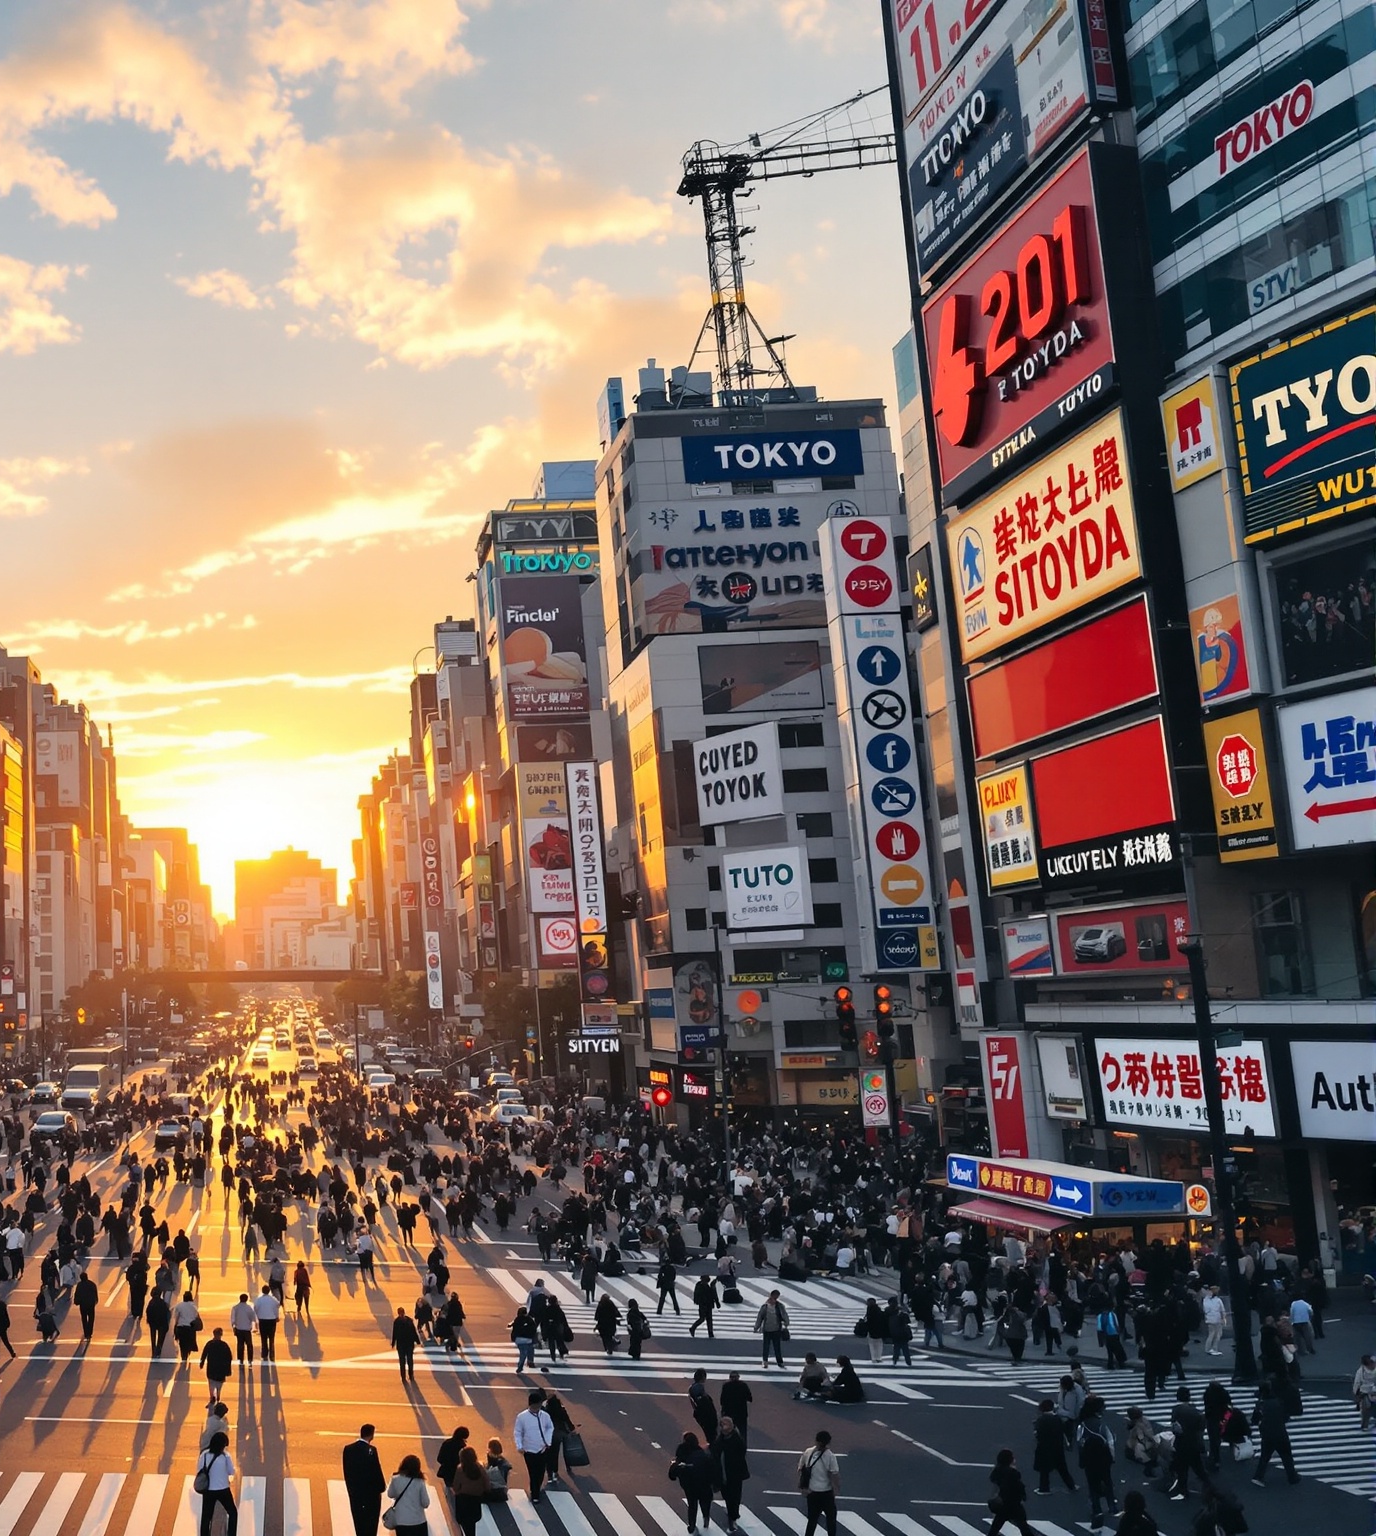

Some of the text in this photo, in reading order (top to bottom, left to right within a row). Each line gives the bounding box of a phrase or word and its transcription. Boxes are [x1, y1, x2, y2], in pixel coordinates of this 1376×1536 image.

[1215, 83, 1312, 175] TOKYO
[714, 441, 836, 469] TOKYO
[995, 504, 1130, 626] SITOYDA
[703, 772, 767, 807] TOYOK
[729, 864, 793, 888] TUTO
[568, 1039, 620, 1053] SITYEN
[1311, 1071, 1376, 1113] Aut
